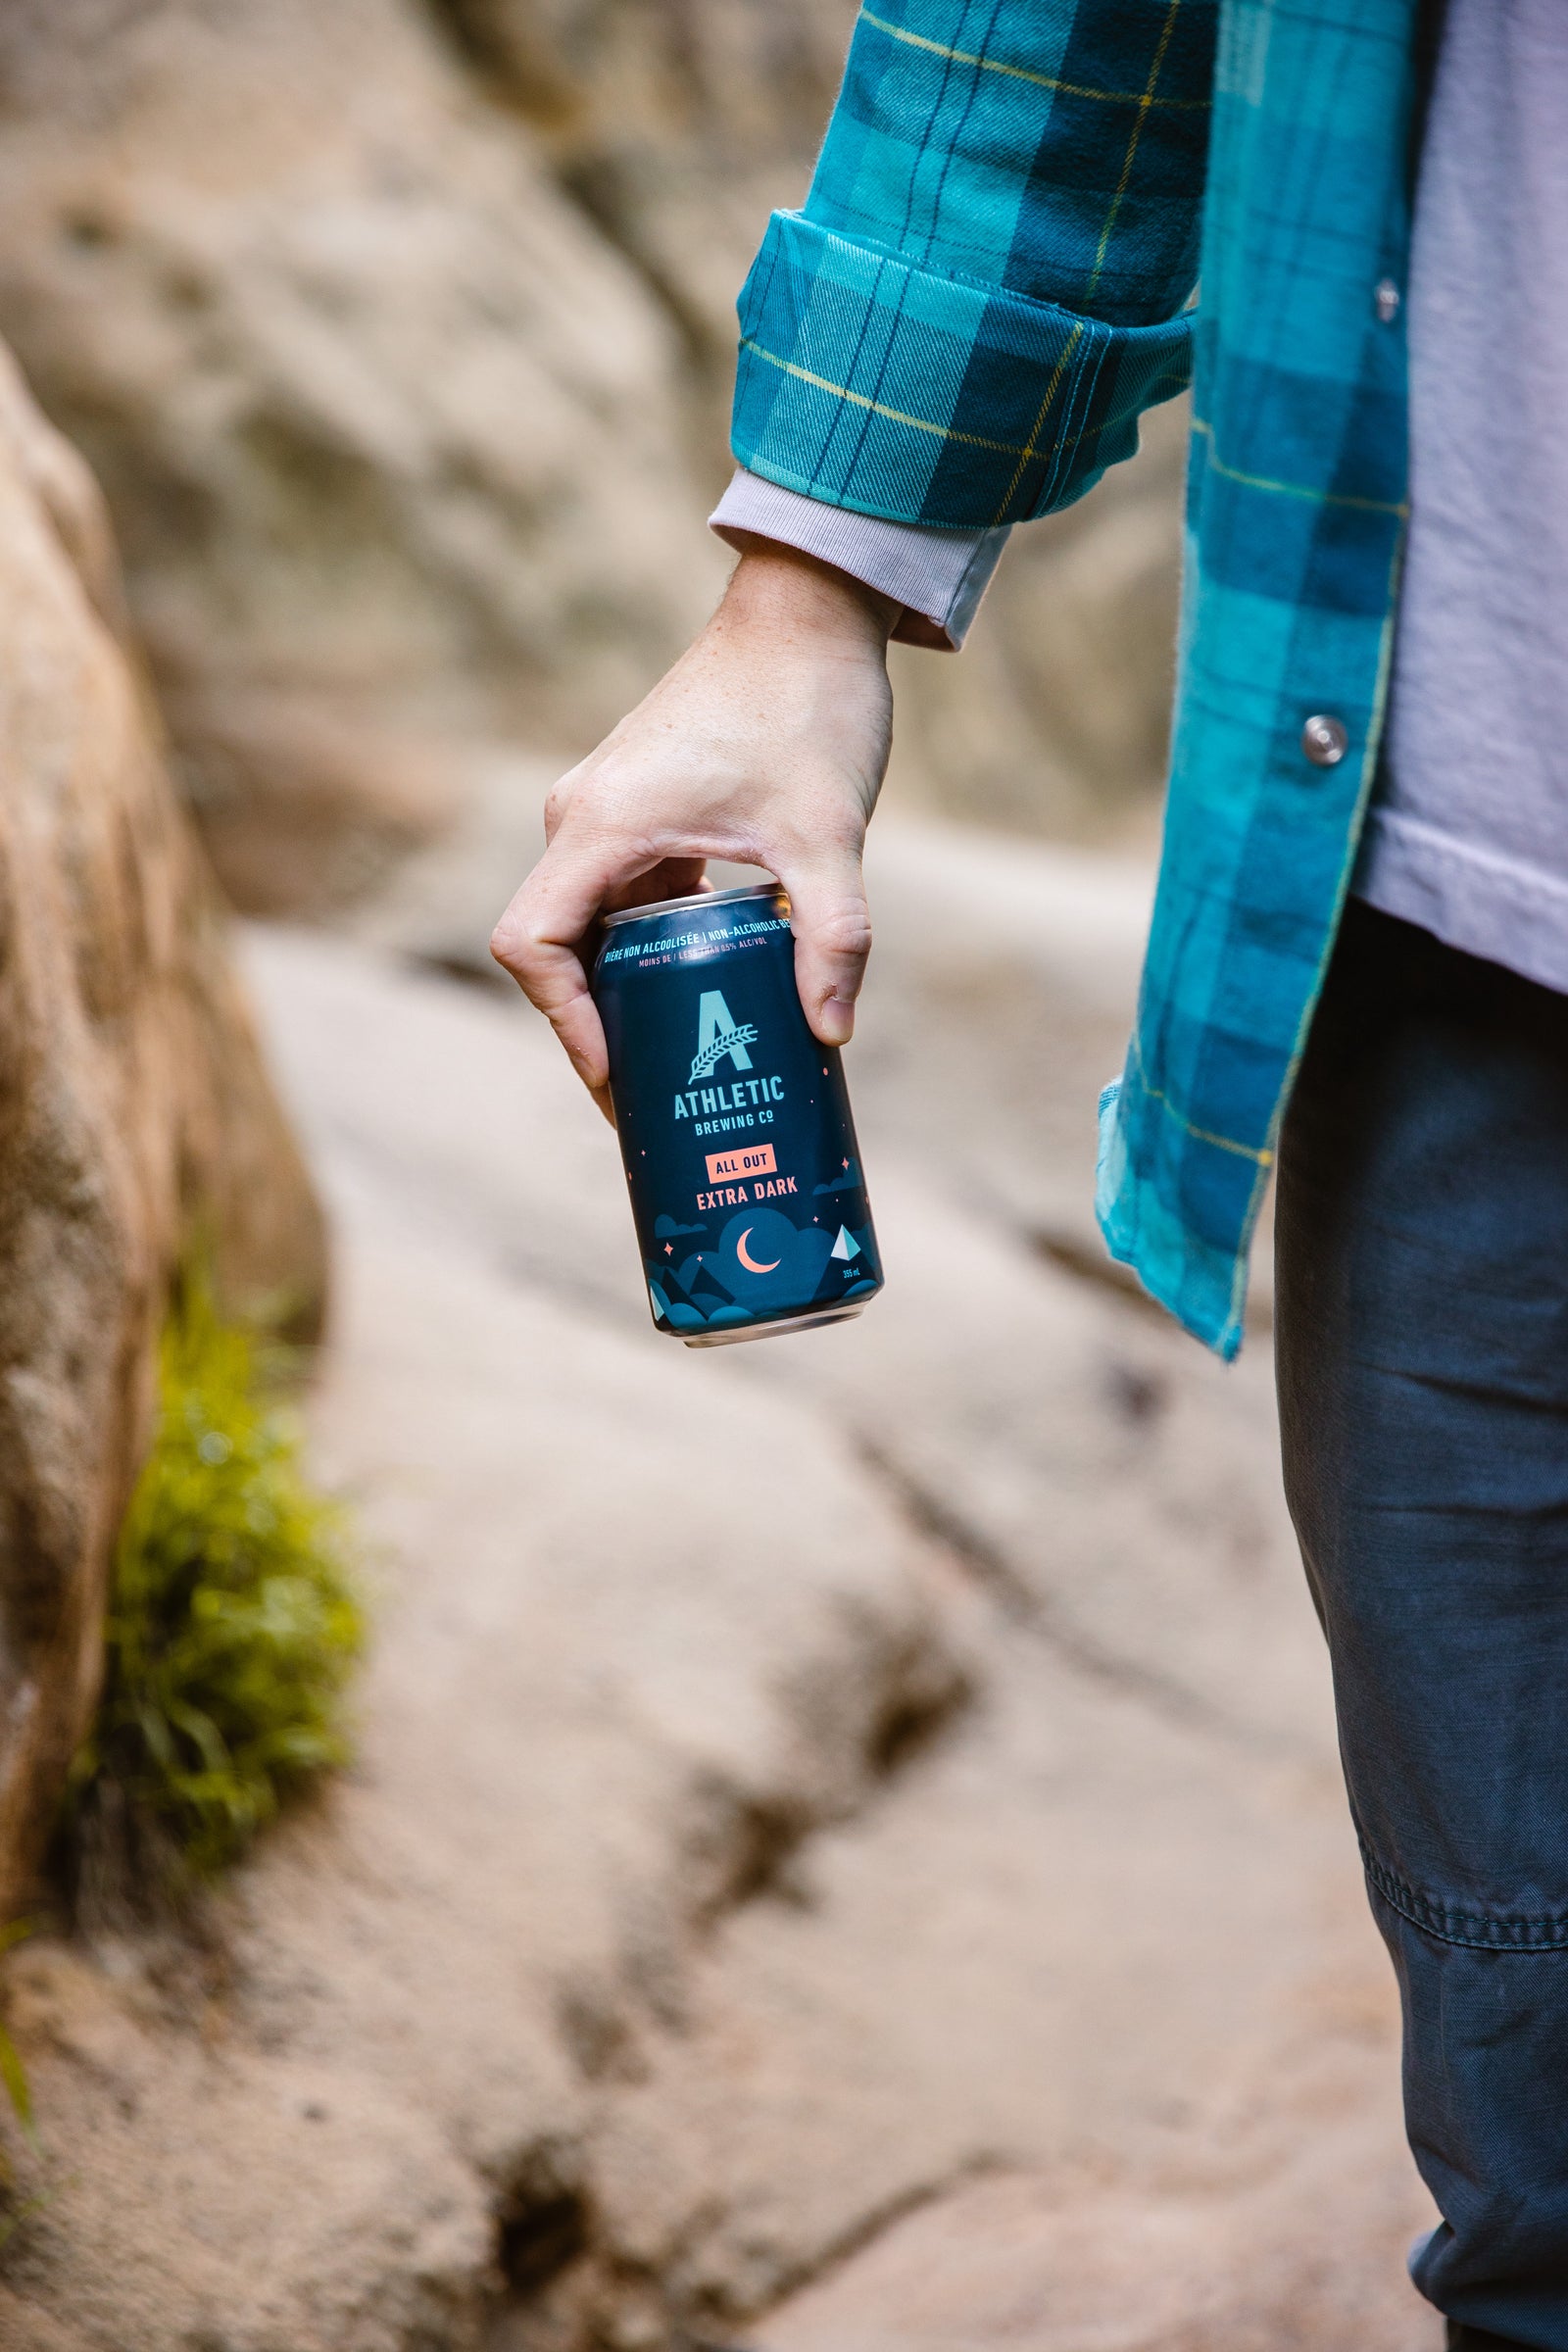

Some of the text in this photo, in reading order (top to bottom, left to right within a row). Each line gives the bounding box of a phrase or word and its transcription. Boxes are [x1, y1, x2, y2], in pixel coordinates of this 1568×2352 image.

[623, 945, 641, 959] NON
[642, 932, 700, 955] ALCOOLISÉE
[708, 919, 780, 941] NON-ALCOHOLIC
[778, 918, 791, 928] BE
[638, 956, 661, 967] MOINS
[678, 949, 698, 959] LESS
[739, 937, 767, 949] ALC/VOL
[674, 1075, 785, 1120] ATHLETIC
[695, 1113, 755, 1136] BREWING
[715, 1152, 767, 1174] ALL OUT
[696, 1176, 799, 1211] EXTRA DARK
[843, 1268, 853, 1278] 355
